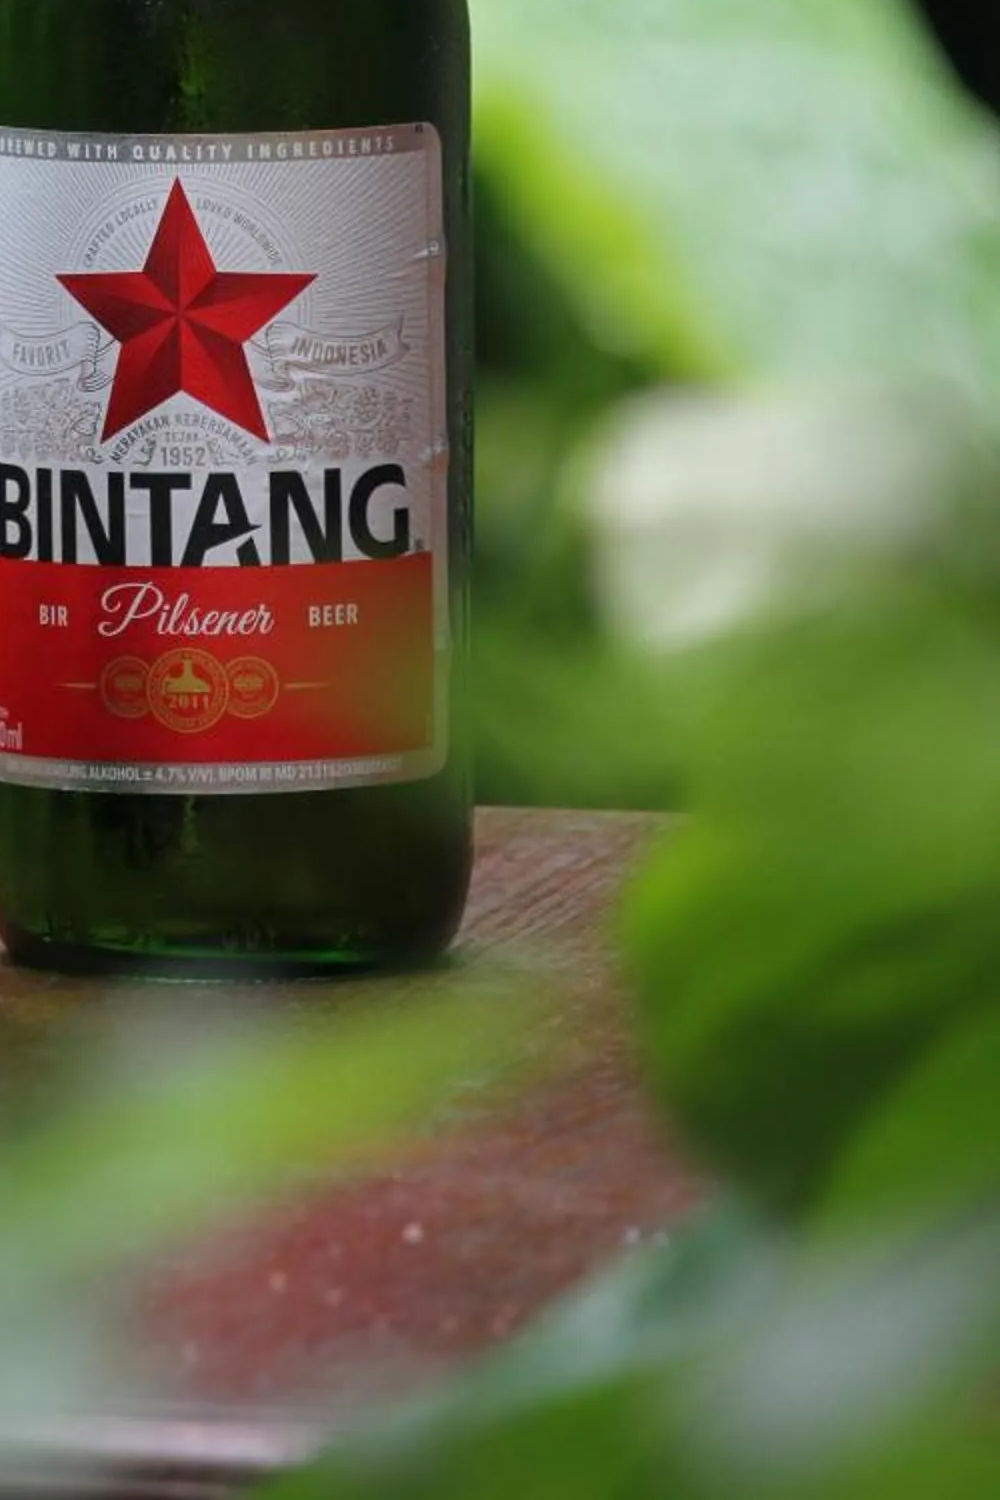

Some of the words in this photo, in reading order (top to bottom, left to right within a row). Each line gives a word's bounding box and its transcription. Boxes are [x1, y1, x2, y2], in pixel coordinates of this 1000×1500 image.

[67, 141, 118, 160] WITH
[133, 144, 232, 160] QUALITY
[247, 136, 394, 159] INGREDIENTS
[12, 339, 71, 367] FAVORIT
[290, 337, 388, 366] INDONESIA
[160, 446, 207, 468] 1952
[39, 604, 69, 626] BIR
[97, 581, 275, 637] Pilsener
[308, 603, 359, 628] BEER
[168, 695, 209, 710] 2011
